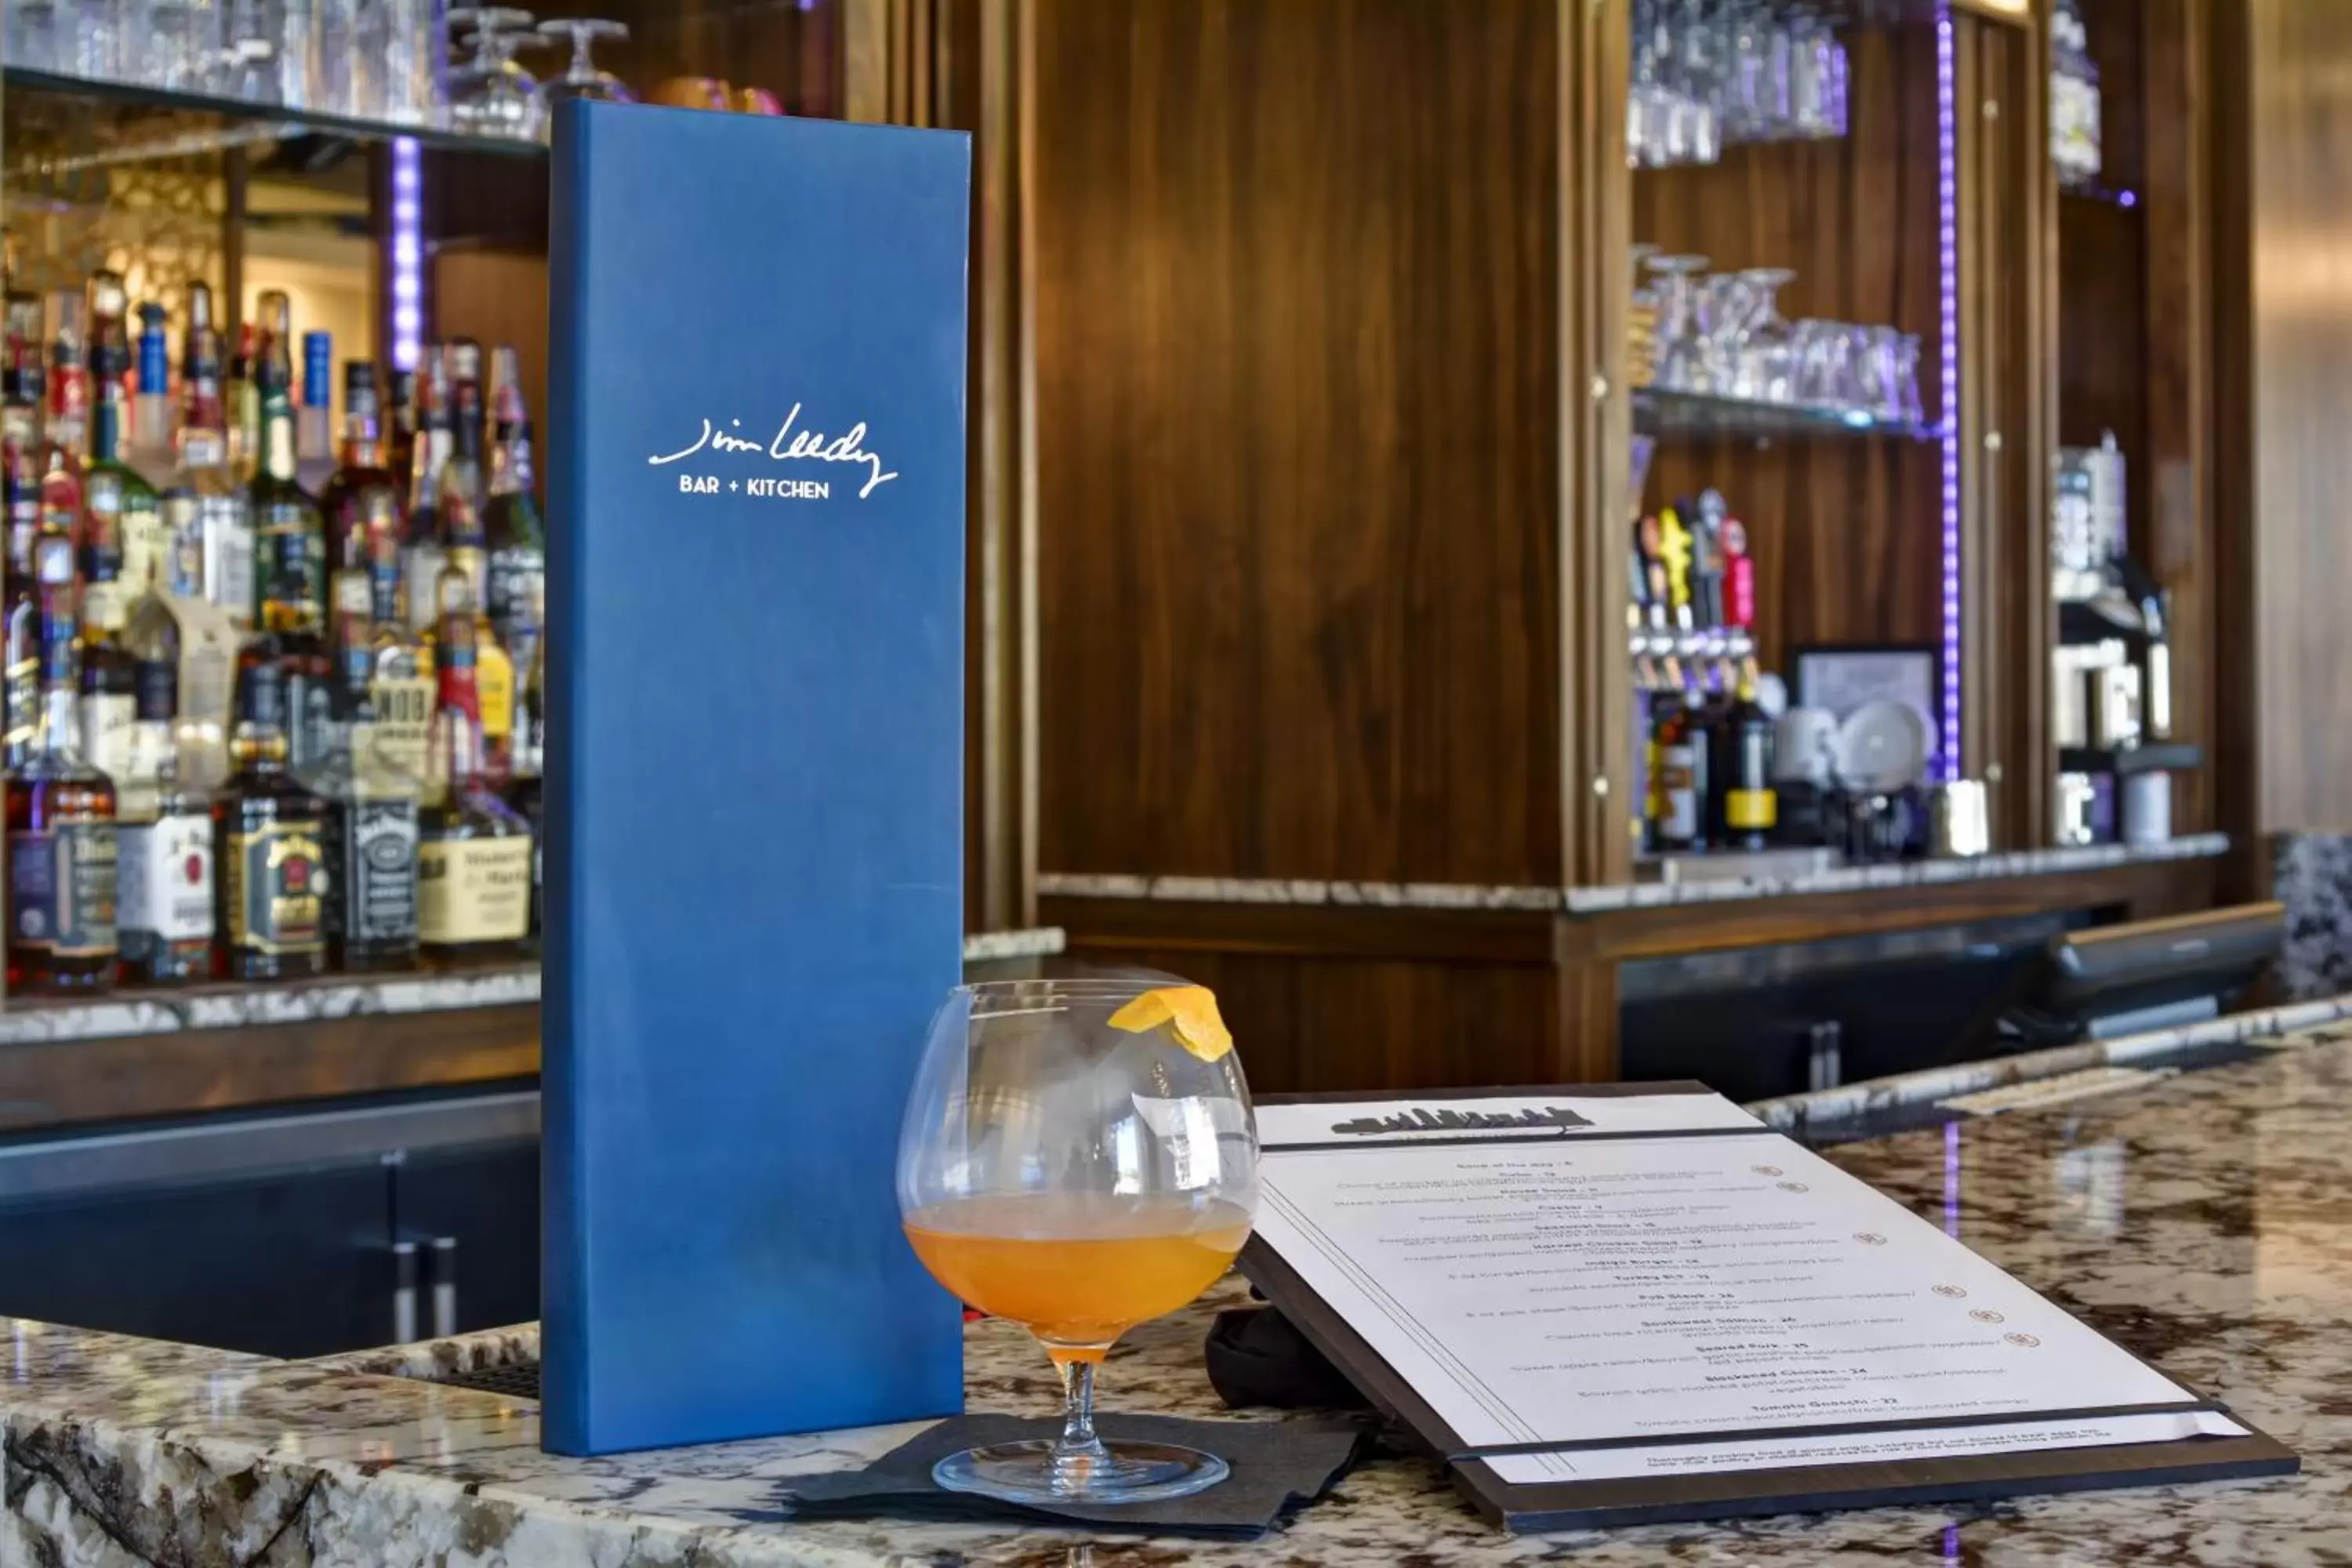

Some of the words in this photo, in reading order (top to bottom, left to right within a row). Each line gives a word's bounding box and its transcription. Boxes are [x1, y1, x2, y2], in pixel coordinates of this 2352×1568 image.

[648, 418, 762, 464] Jim
[769, 402, 898, 499] Leedy
[679, 474, 720, 494] BAR
[746, 477, 829, 499] KITCHEN
